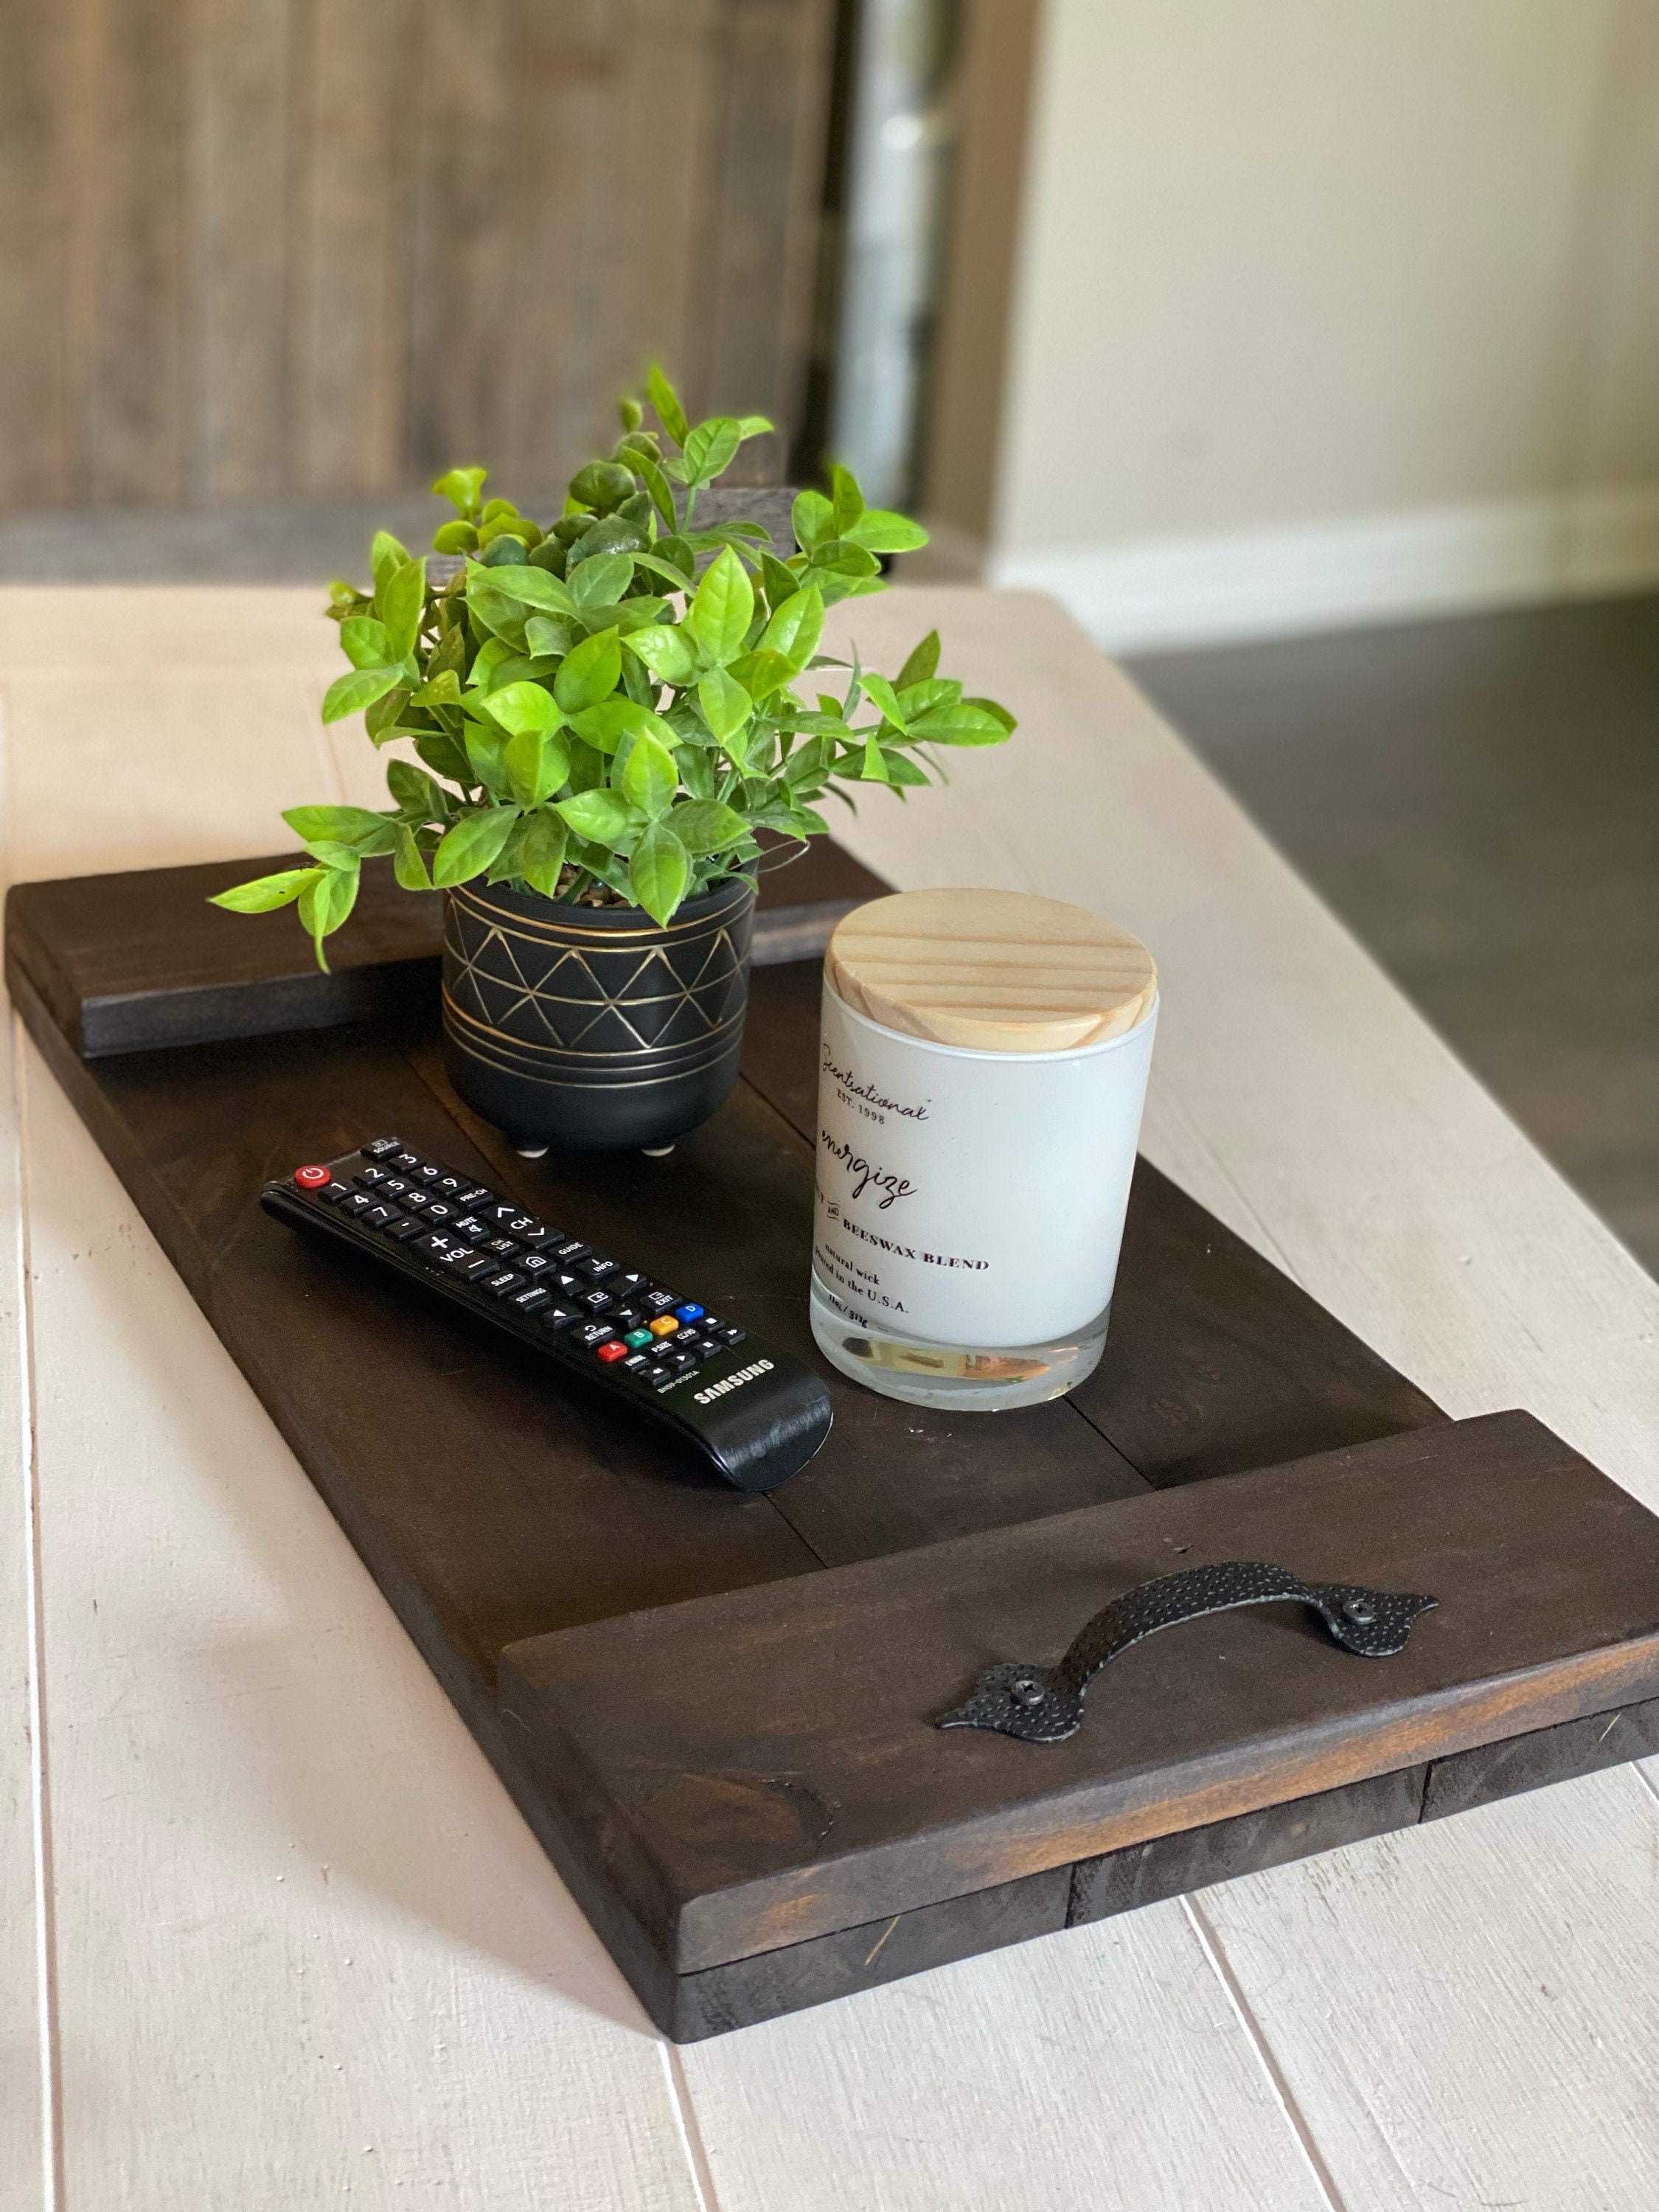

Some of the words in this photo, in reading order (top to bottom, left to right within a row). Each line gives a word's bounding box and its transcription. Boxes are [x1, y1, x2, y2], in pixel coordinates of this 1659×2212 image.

[859, 1105, 885, 1124] 1998
[373, 1141, 401, 1153] SOURCE
[399, 1154, 417, 1164] 3
[365, 1169, 384, 1178] 2
[423, 1166, 437, 1175] 6
[821, 1130, 917, 1209] energize
[387, 1180, 404, 1190] 5
[442, 1178, 456, 1187] 9
[355, 1195, 369, 1203] 4
[408, 1193, 426, 1202] 8
[460, 1189, 487, 1201] PRE-CH
[372, 1207, 387, 1217] 7
[431, 1206, 448, 1214] 0
[456, 1217, 478, 1228] MUTE
[511, 1217, 533, 1229] CH
[499, 1241, 513, 1250] LIST
[559, 1242, 583, 1254] GUIDE
[843, 1217, 917, 1259] BEESWAX
[923, 1252, 989, 1270] BLEND
[439, 1248, 474, 1262] VOL
[593, 1261, 613, 1272] INFO
[825, 1243, 853, 1272] natural
[856, 1268, 880, 1285] wick
[491, 1274, 514, 1286] SLEEP
[516, 1288, 546, 1303] SETTINGS
[836, 1270, 844, 1284] in
[848, 1280, 864, 1295] the
[867, 1289, 908, 1313] U.S.A.
[655, 1295, 673, 1305] EXIT
[661, 1316, 671, 1324] C
[585, 1326, 613, 1340] RETURN
[694, 1360, 775, 1404] SAMSUNG
